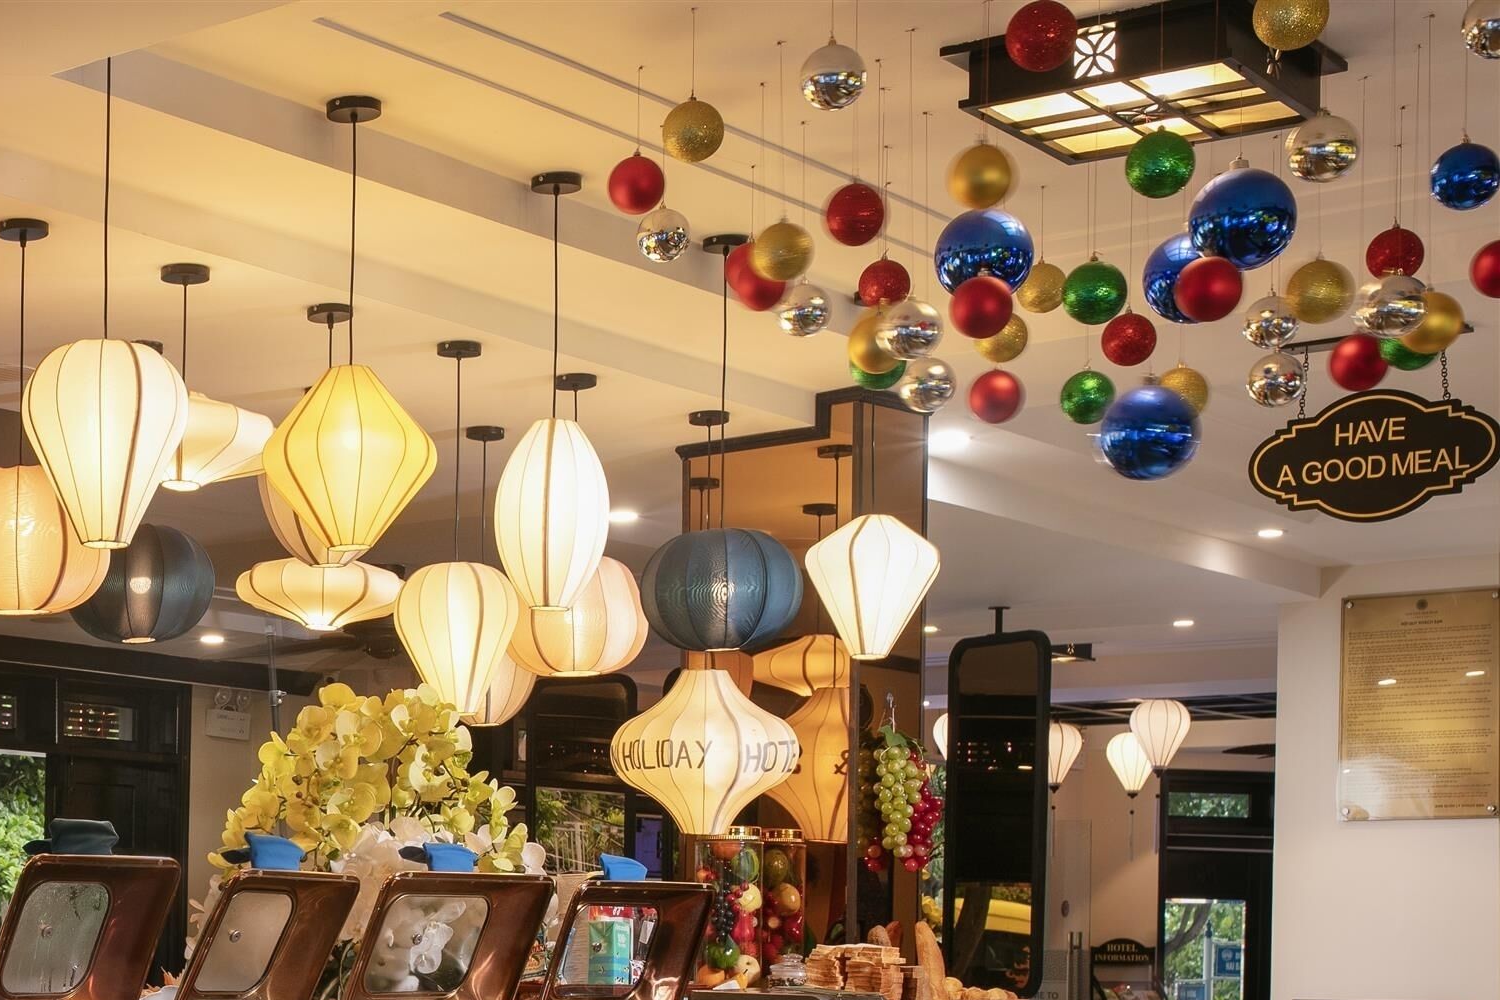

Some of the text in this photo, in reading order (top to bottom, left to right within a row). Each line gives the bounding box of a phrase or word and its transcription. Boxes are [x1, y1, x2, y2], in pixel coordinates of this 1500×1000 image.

[1335, 417, 1406, 447] HAVE
[1276, 445, 1470, 488] A GOOD MEAL
[622, 739, 713, 772] HOLIDAY
[1094, 953, 1149, 961] INFORMATION
[1107, 943, 1138, 952] HOTEL
[1047, 991, 1059, 1000] TO
